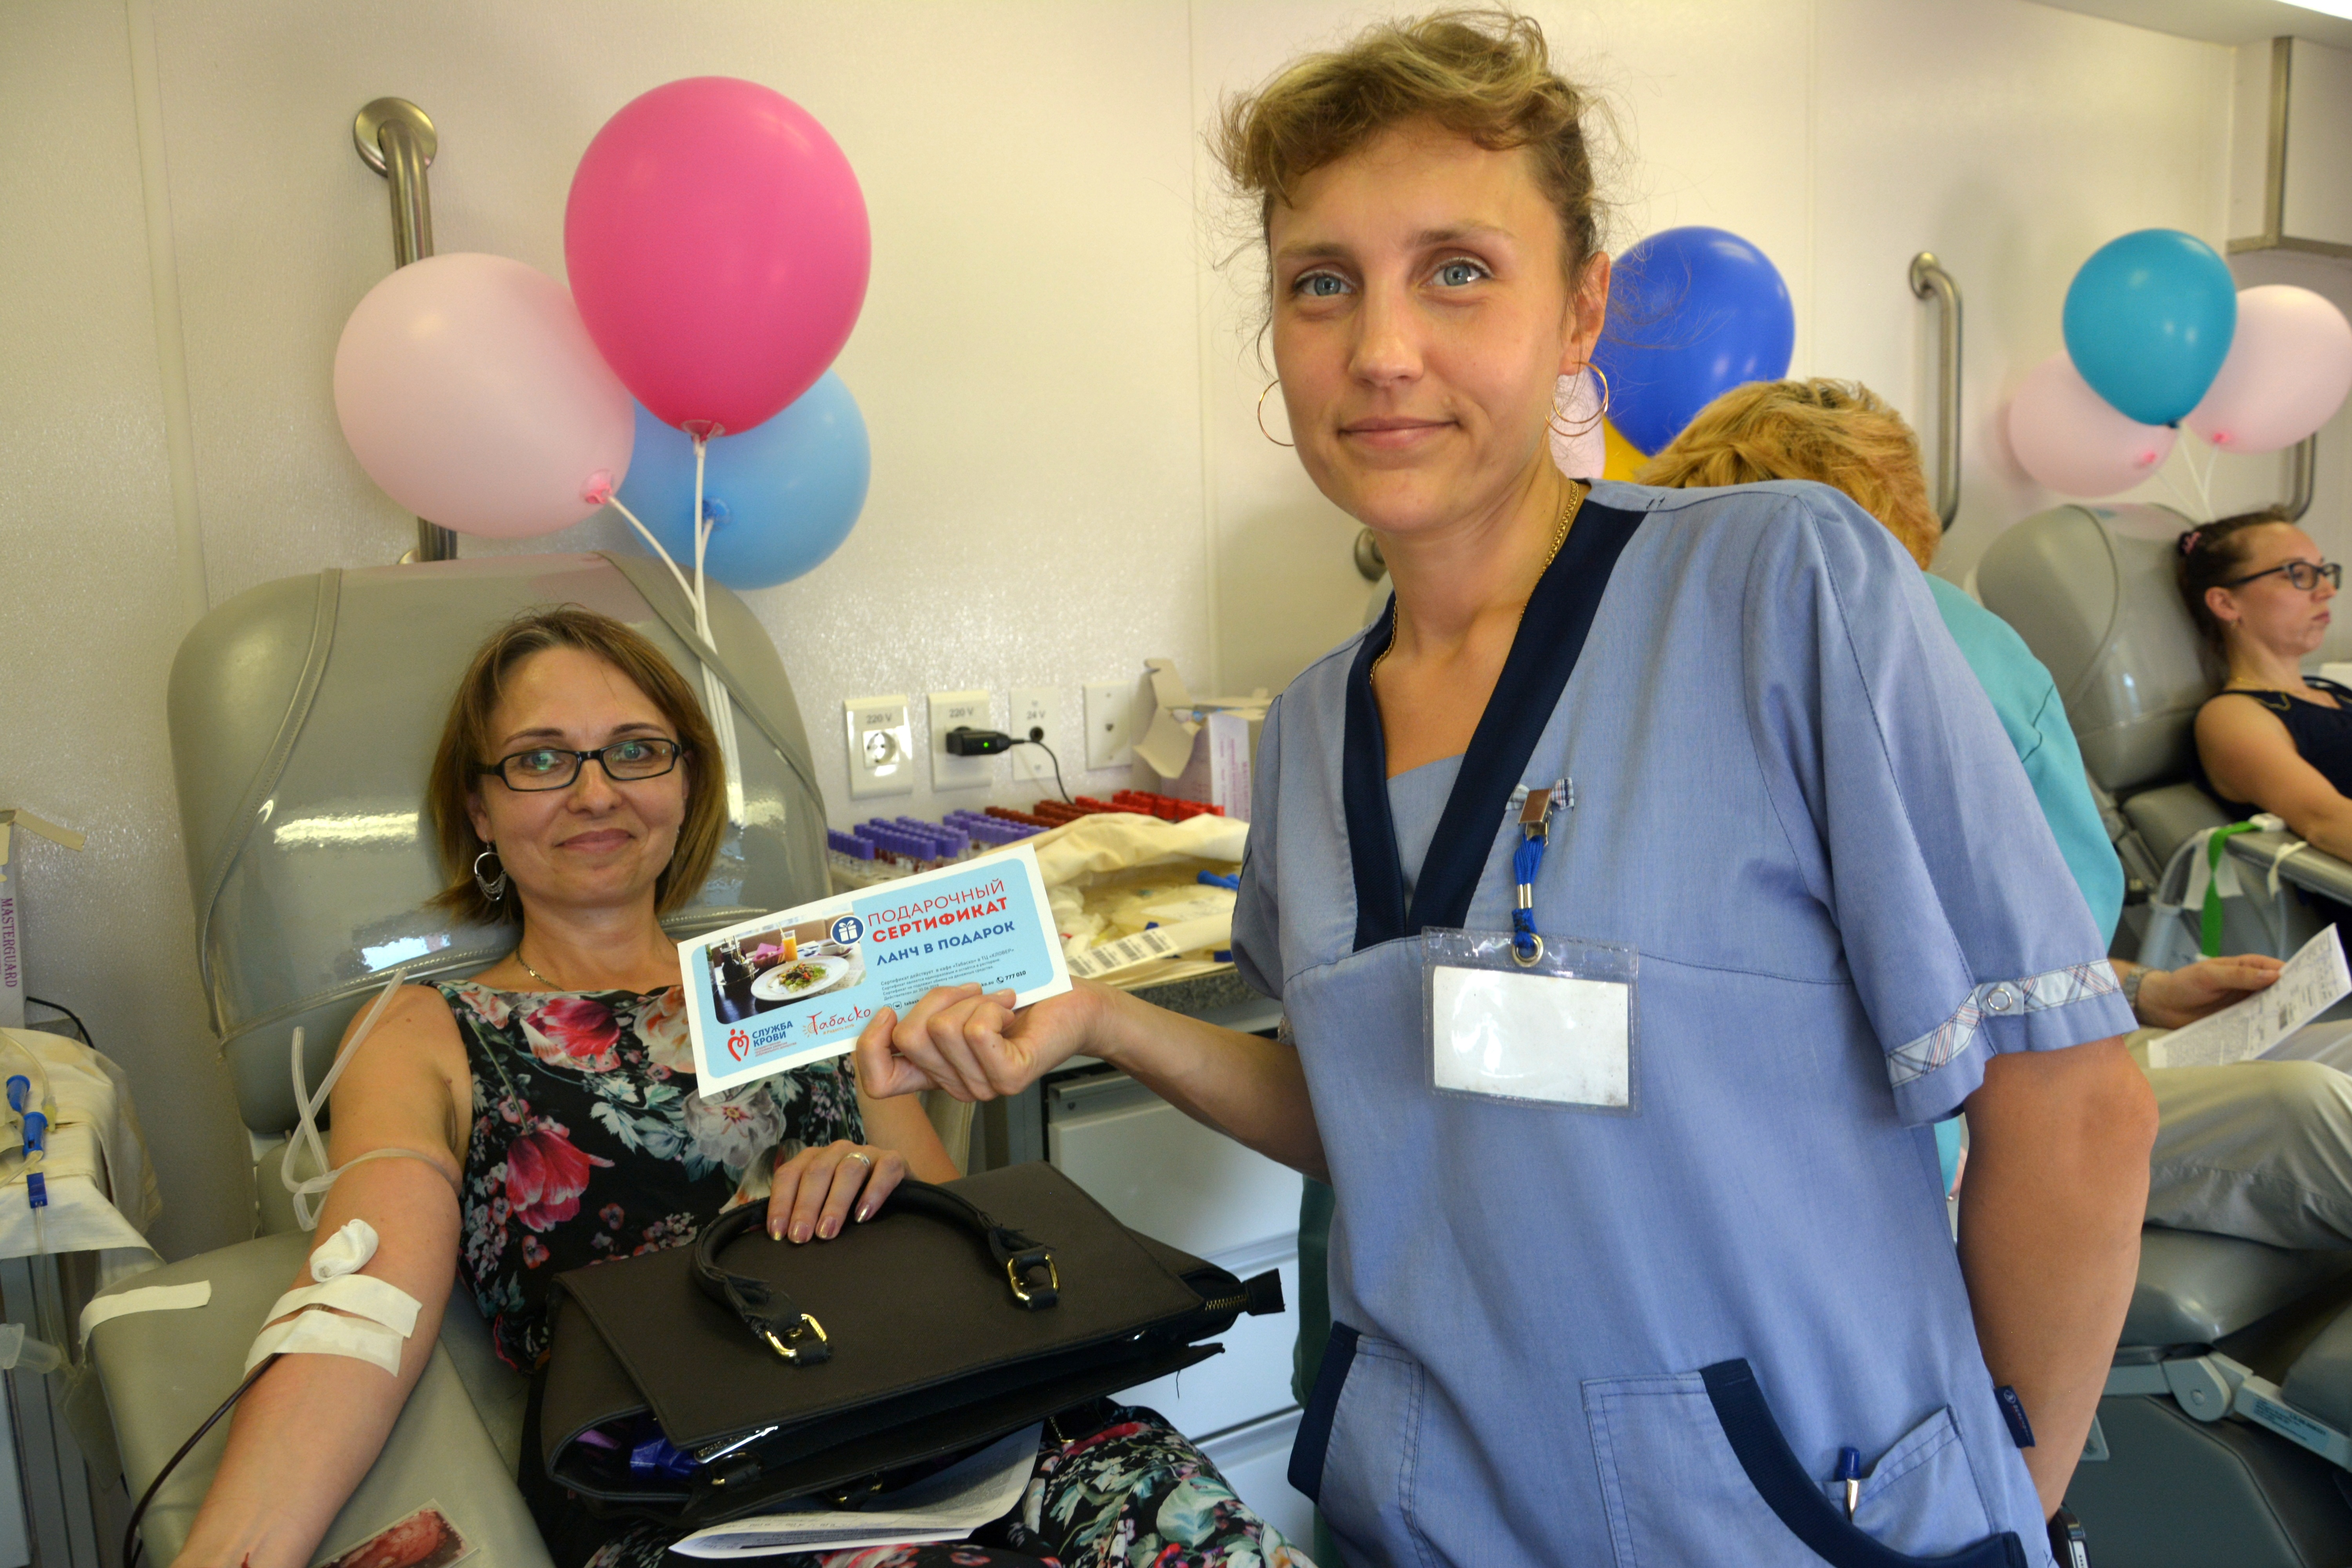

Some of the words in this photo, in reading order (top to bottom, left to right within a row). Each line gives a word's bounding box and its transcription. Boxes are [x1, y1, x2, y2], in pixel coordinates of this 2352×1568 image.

[867, 714, 884, 724] 220
[885, 713, 893, 722] V
[950, 709, 965, 717] 220
[967, 708, 974, 716] V
[867, 878, 1005, 926] ПОДАРОЧНЫЙ
[873, 897, 1007, 942] СЕРТИФИКАТ
[1, 898, 18, 987] MASTERGUARD
[877, 946, 919, 966] ЛАНЧ
[924, 943, 933, 953] В
[938, 921, 1015, 950] ПОДАРОК
[881, 976, 909, 985] Сертификат
[910, 970, 933, 979] действует
[882, 982, 906, 990] Сертификат
[925, 971, 955, 980] единоразовым
[883, 987, 907, 995] Сертификат
[884, 992, 912, 1000] Действителен
[806, 1004, 871, 1035] Табаско
[752, 1020, 793, 1039] СЛУЖБА
[753, 1031, 786, 1047] КРОВИ
